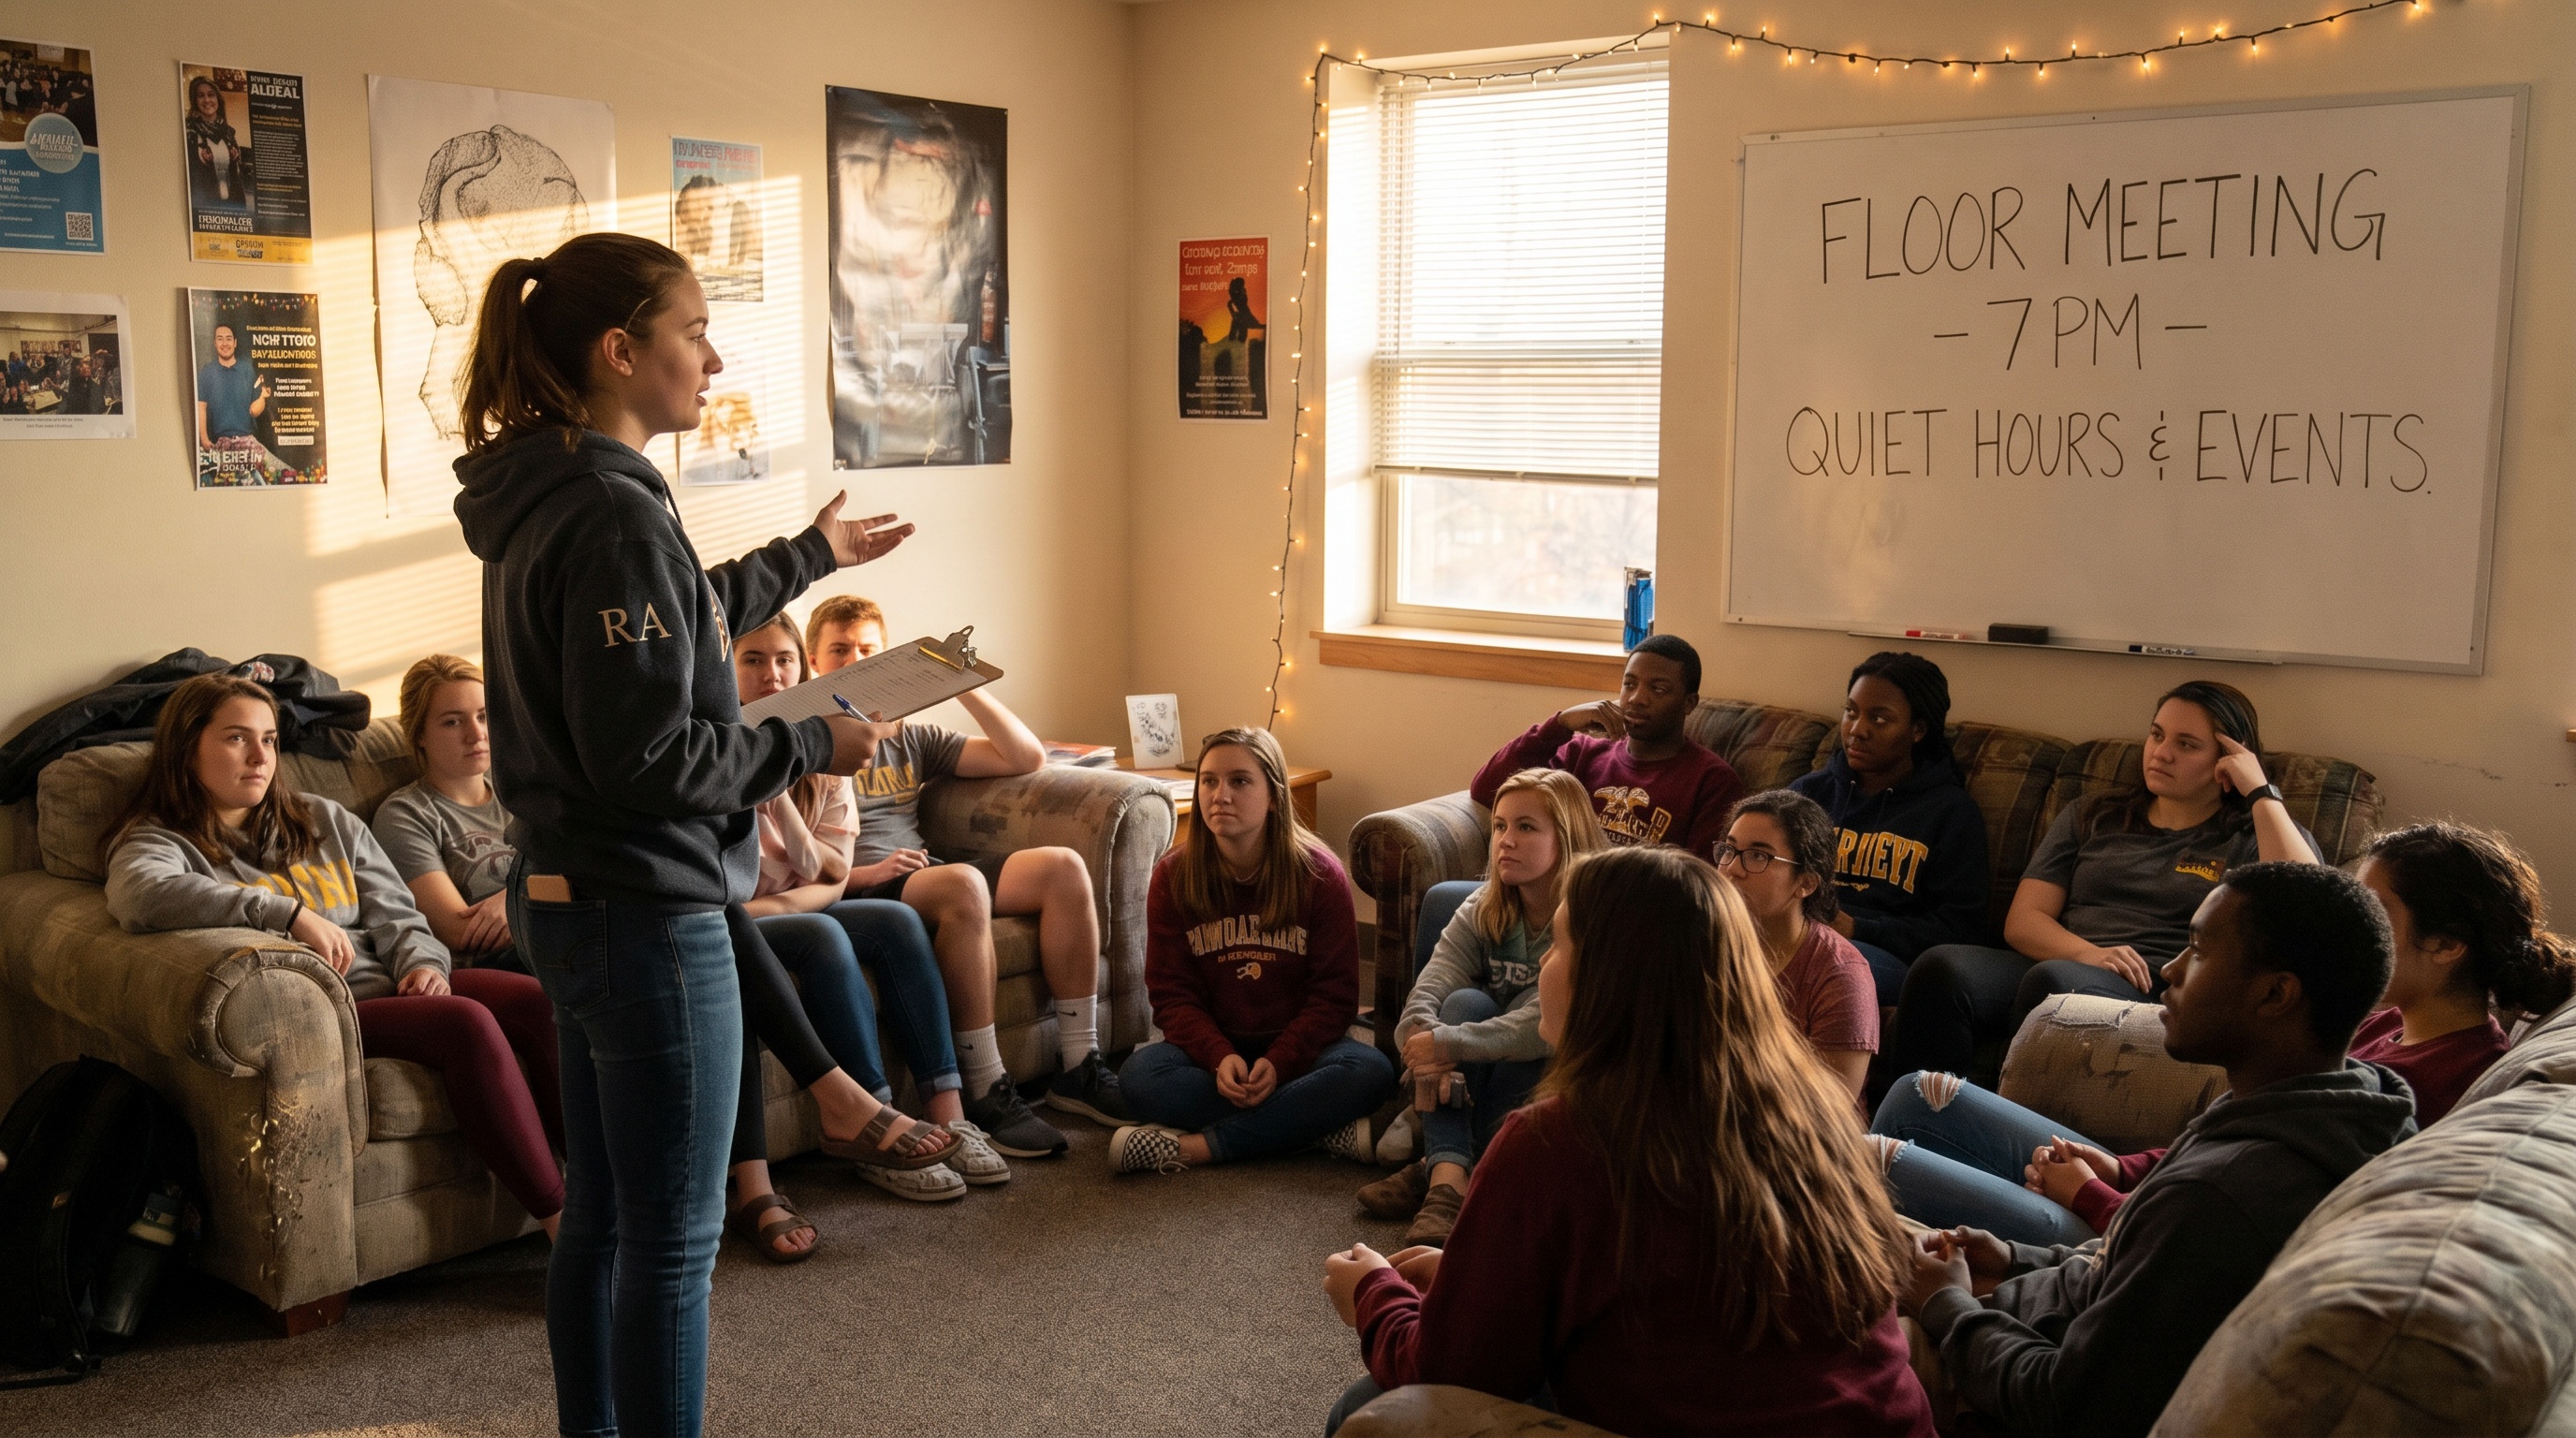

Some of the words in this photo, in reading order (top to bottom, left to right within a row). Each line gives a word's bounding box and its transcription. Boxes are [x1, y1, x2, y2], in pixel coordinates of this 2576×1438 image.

[1822, 185, 2027, 284] FLOOR
[2064, 168, 2386, 268] MEETING
[1986, 297, 2033, 372] 7
[2052, 292, 2143, 371] PM
[1785, 405, 1948, 477] QUIET
[1974, 408, 2125, 479] HOURS
[597, 602, 673, 648] RA
